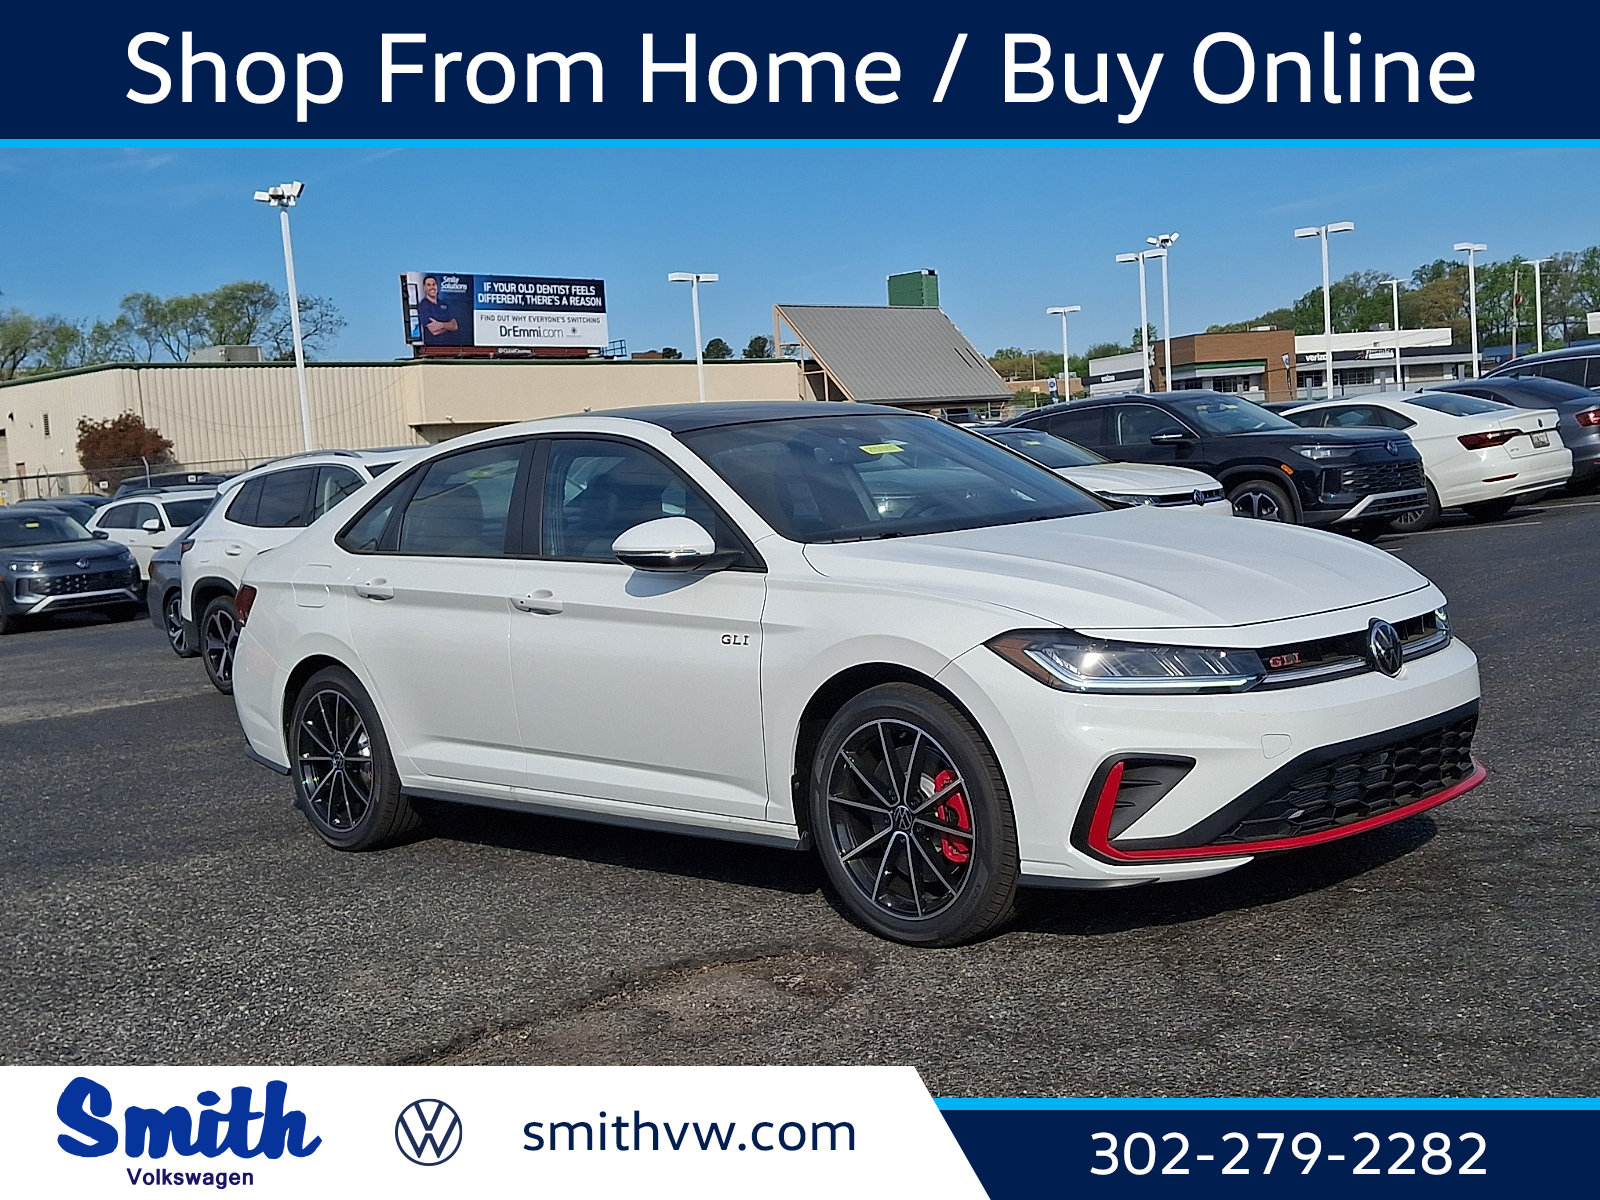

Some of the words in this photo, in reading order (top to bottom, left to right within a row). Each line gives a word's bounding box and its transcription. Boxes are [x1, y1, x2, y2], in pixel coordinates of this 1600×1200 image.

[441, 282, 468, 290] Solutions
[443, 276, 460, 284] Smile
[483, 282, 491, 292] IF
[493, 282, 517, 293] YOUR
[518, 283, 535, 293] OLD
[536, 284, 570, 295] DENTIST
[572, 285, 596, 296] FEELS
[478, 293, 524, 306] DIFFERENT,
[525, 294, 560, 306] THERE'S
[562, 296, 568, 306] A
[570, 296, 602, 307] REASON
[480, 314, 496, 322] FIND
[511, 315, 527, 323] WHY
[499, 325, 564, 338] DrEmmi.com
[1305, 352, 1327, 362] verizo
[721, 634, 749, 646] GLI
[1269, 652, 1301, 668] GLI
